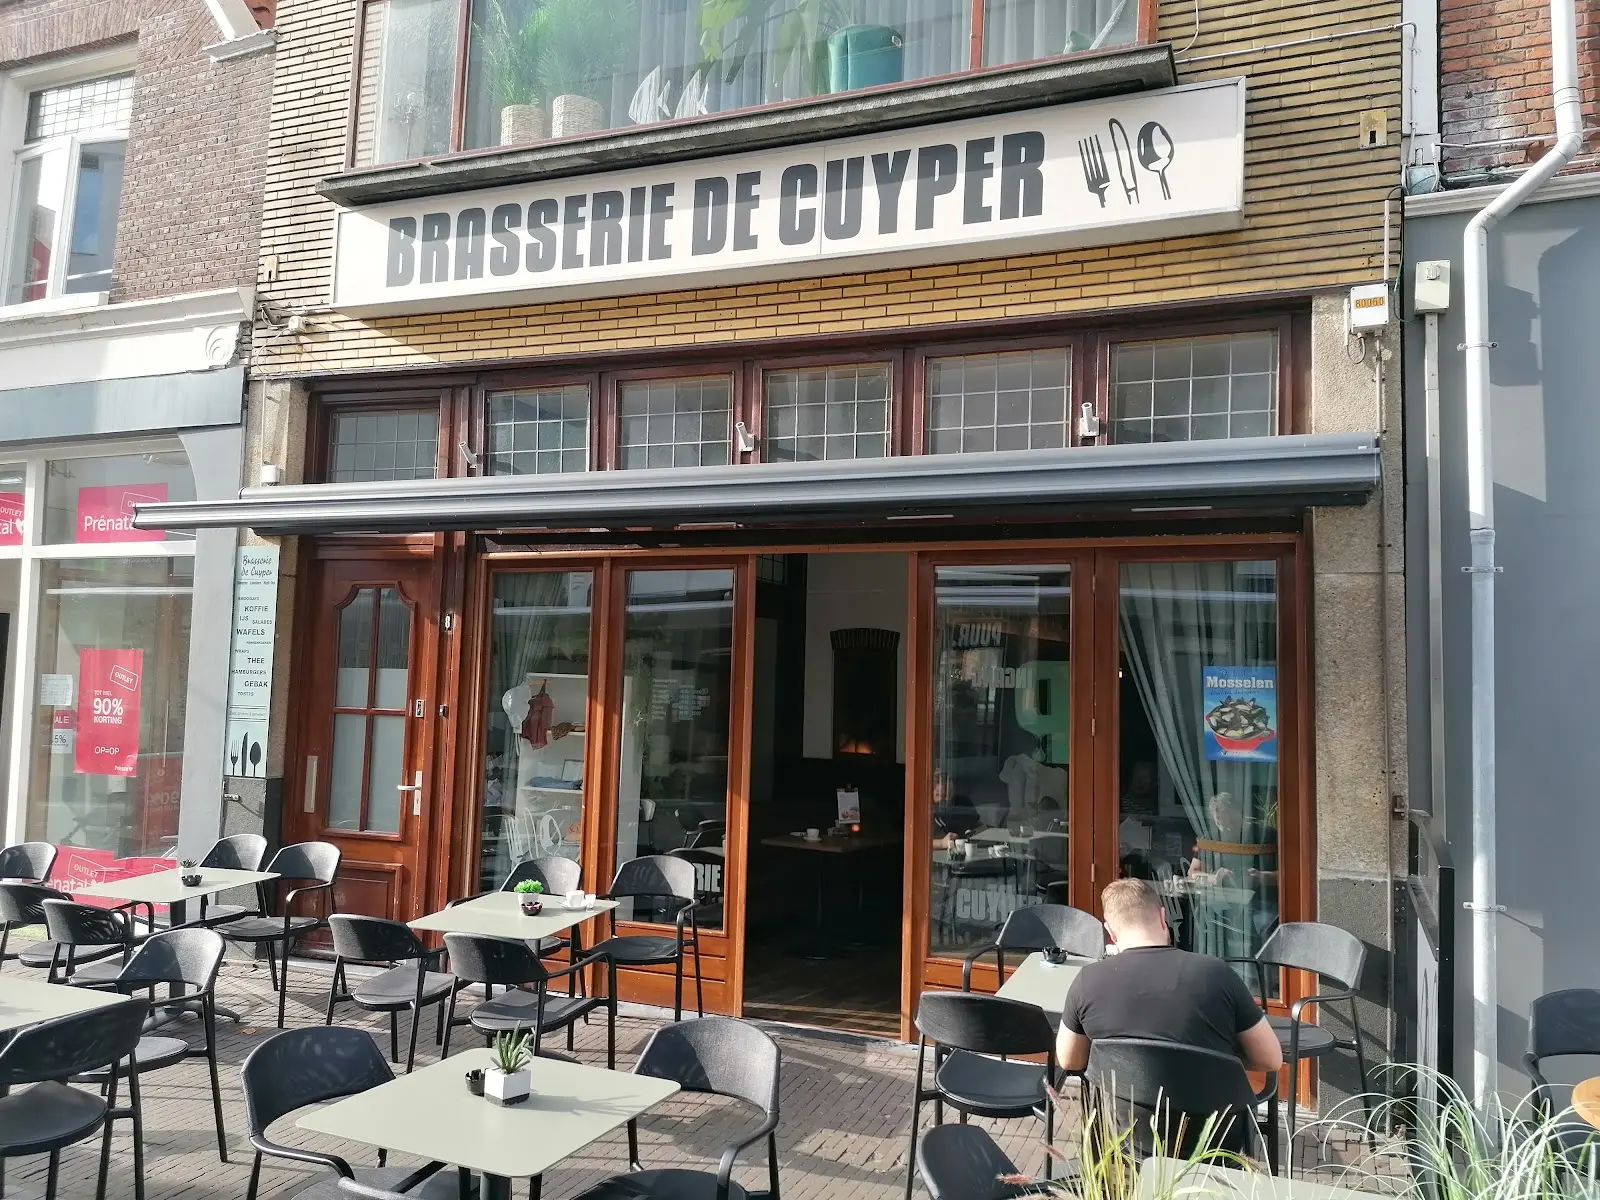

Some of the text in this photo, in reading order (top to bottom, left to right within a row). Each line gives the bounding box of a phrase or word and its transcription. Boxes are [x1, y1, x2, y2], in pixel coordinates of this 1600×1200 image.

[386, 130, 1046, 288] BRASSERIE DE CUYPER
[0, 506, 23, 517] OUTLET
[242, 555, 272, 566] Brasserie
[240, 566, 272, 578] de Cuyper
[236, 628, 266, 636] WAFELS
[114, 671, 134, 684] OUTLET
[1206, 676, 1274, 689] Mosselen
[244, 680, 268, 688] GEBAK
[93, 698, 124, 716] 90%
[54, 716, 70, 724] ALE
[93, 715, 123, 725] KORTING
[94, 746, 120, 755] OP=OP
[74, 863, 99, 878] OUTLET
